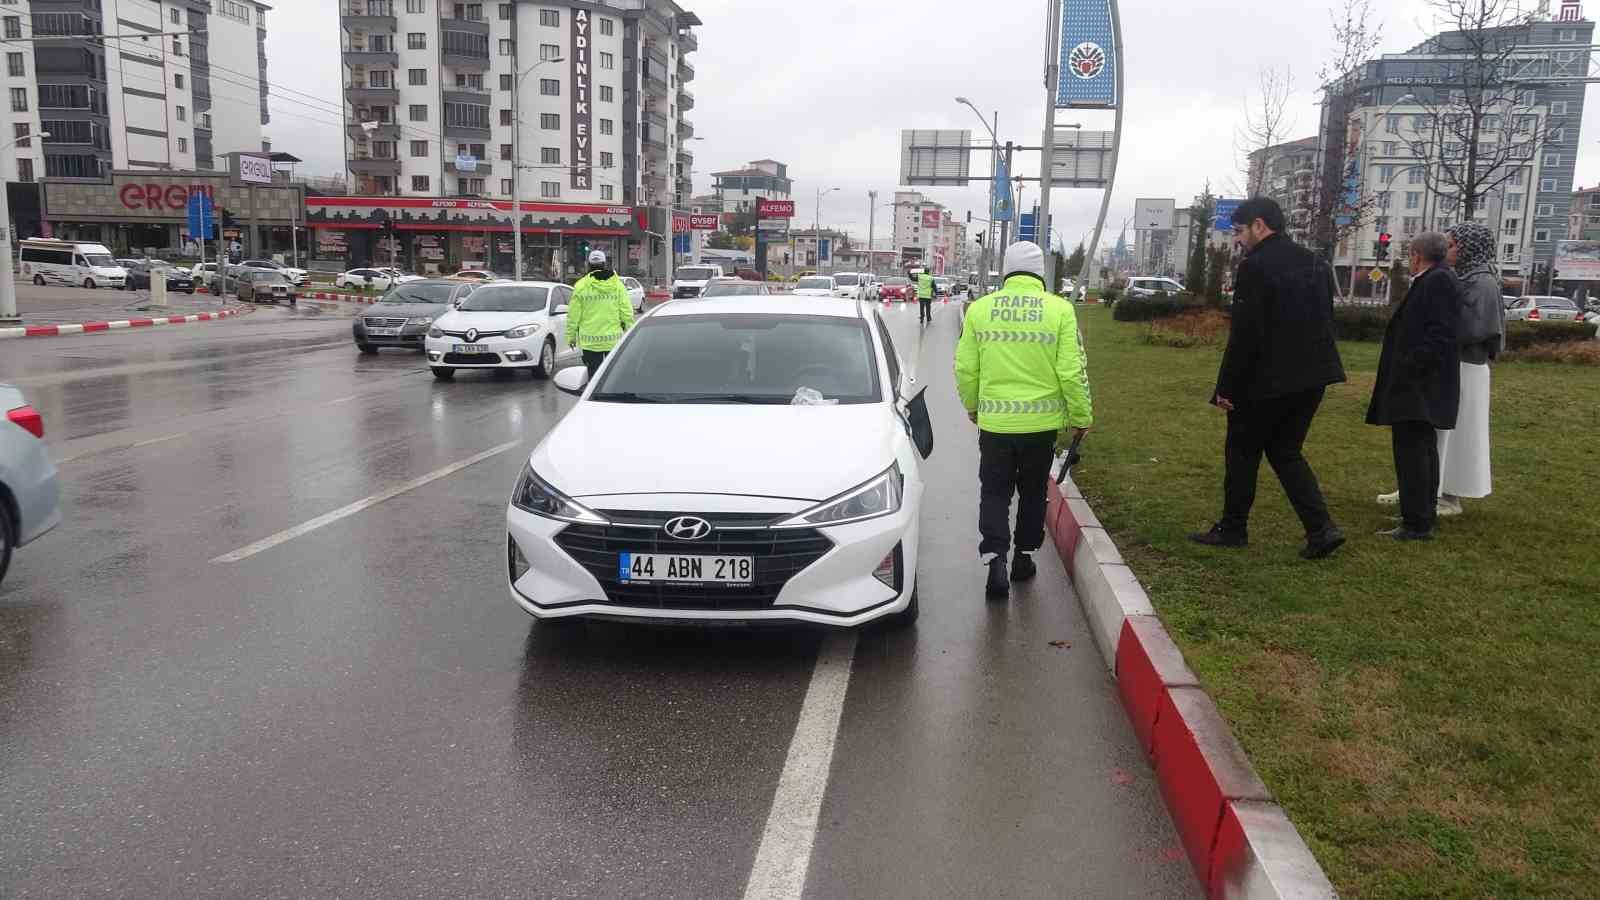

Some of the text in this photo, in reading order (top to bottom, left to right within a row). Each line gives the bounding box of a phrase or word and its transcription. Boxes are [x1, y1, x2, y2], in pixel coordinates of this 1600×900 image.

[576, 10, 588, 187] AYDINLIK EVLER
[760, 204, 793, 213] ALFEMO
[632, 556, 751, 579] 44 ABN 218
